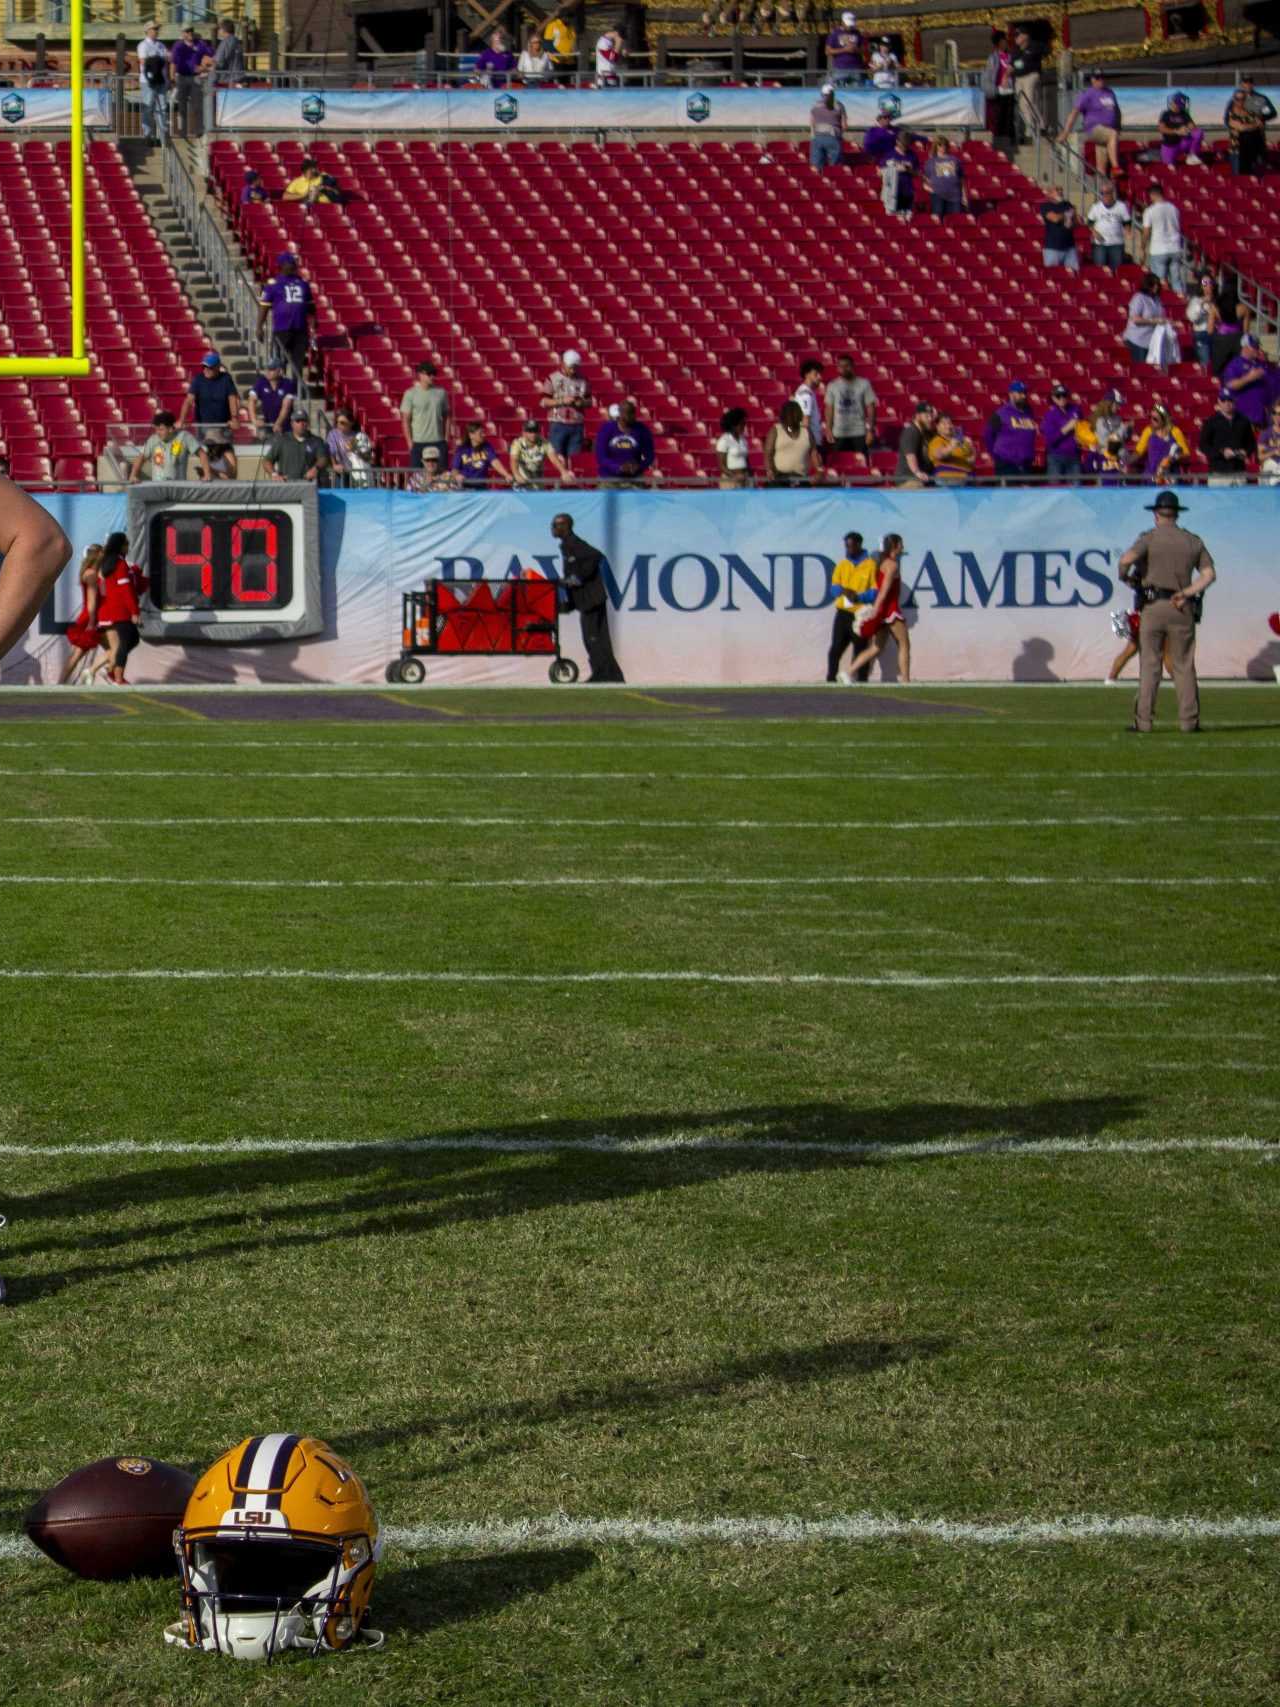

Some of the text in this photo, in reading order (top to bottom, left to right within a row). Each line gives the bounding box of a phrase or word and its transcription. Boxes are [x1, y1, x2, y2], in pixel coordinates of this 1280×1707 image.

[283, 285, 304, 303] 12
[166, 519, 278, 602] 40
[870, 549, 1114, 608] AMES
[233, 1511, 272, 1525] LSU
